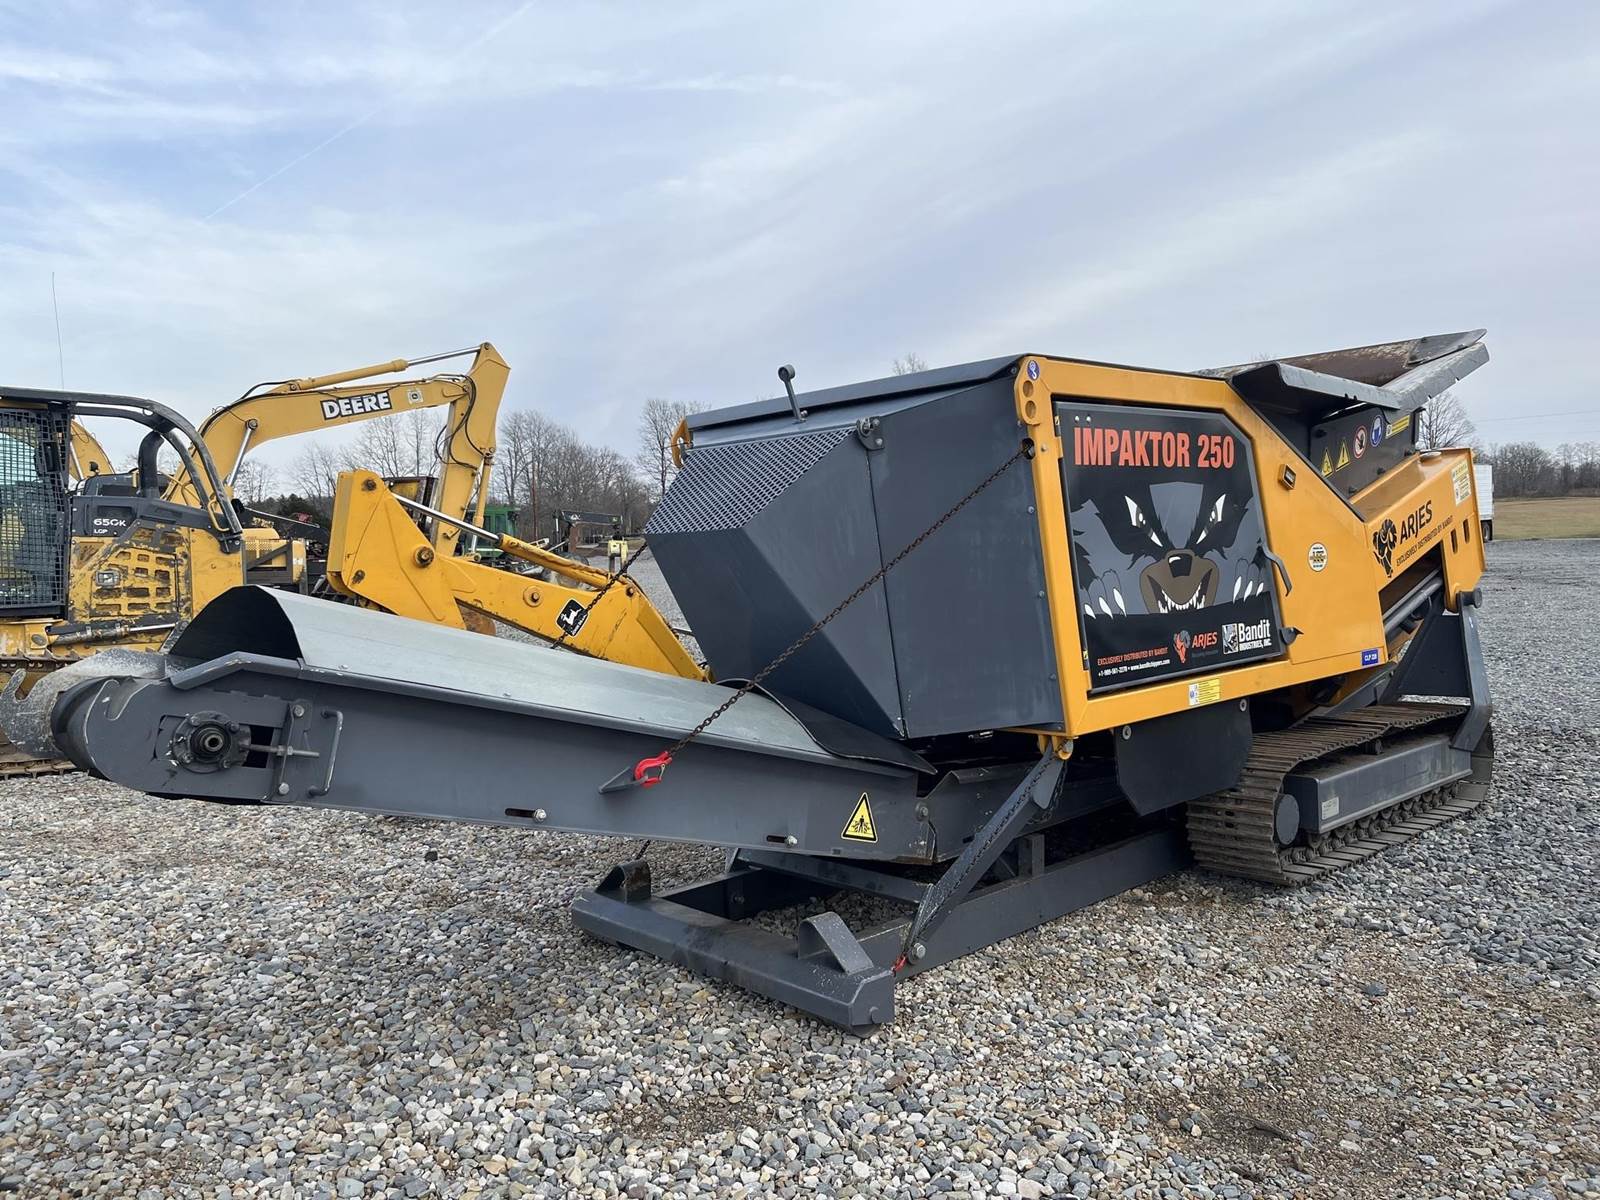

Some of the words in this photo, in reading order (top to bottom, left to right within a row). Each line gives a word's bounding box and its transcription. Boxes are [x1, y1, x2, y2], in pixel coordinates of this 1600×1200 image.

[322, 392, 391, 419] DEERE
[1074, 427, 1190, 467] IMPAKTOR
[1197, 434, 1234, 469] 250
[93, 518, 127, 527] 650K
[1400, 499, 1433, 545] ARJES
[1191, 631, 1218, 649] ARJES
[1238, 619, 1271, 642] Bandit
